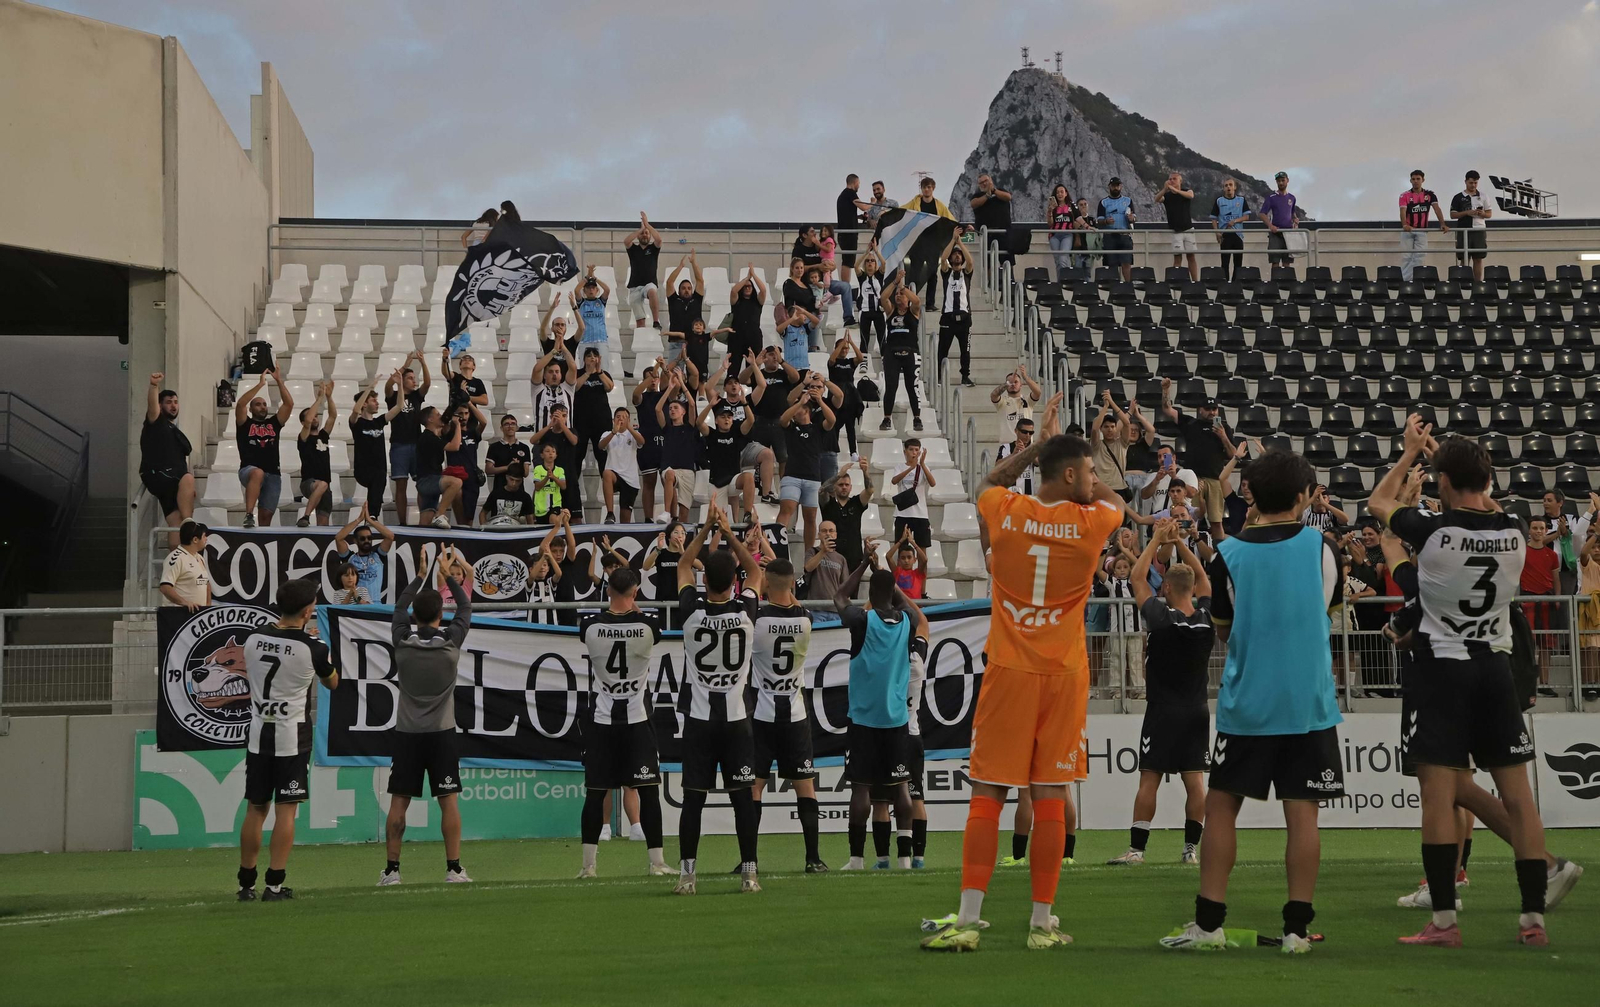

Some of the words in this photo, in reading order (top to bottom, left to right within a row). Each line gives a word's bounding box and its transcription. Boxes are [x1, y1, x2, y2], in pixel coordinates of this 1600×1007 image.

[249, 346, 258, 365] FILA
[1001, 515, 1018, 532] A.
[1023, 518, 1082, 539] MIGUEL
[1440, 534, 1455, 550] P.
[1460, 536, 1518, 553] MORILLO
[1027, 544, 1050, 607] 1
[1458, 556, 1500, 617] 3
[597, 628, 645, 638] MARLONE
[768, 624, 804, 635] ISMAEL
[255, 640, 280, 654] PEPE
[284, 645, 296, 656] R.
[694, 627, 747, 673] 20
[772, 635, 796, 676] 5
[605, 640, 629, 680] 4
[168, 669, 182, 683] 19
[259, 654, 282, 700] 7
[1307, 779, 1324, 790] Ruiz
[1391, 789, 1420, 809] de
